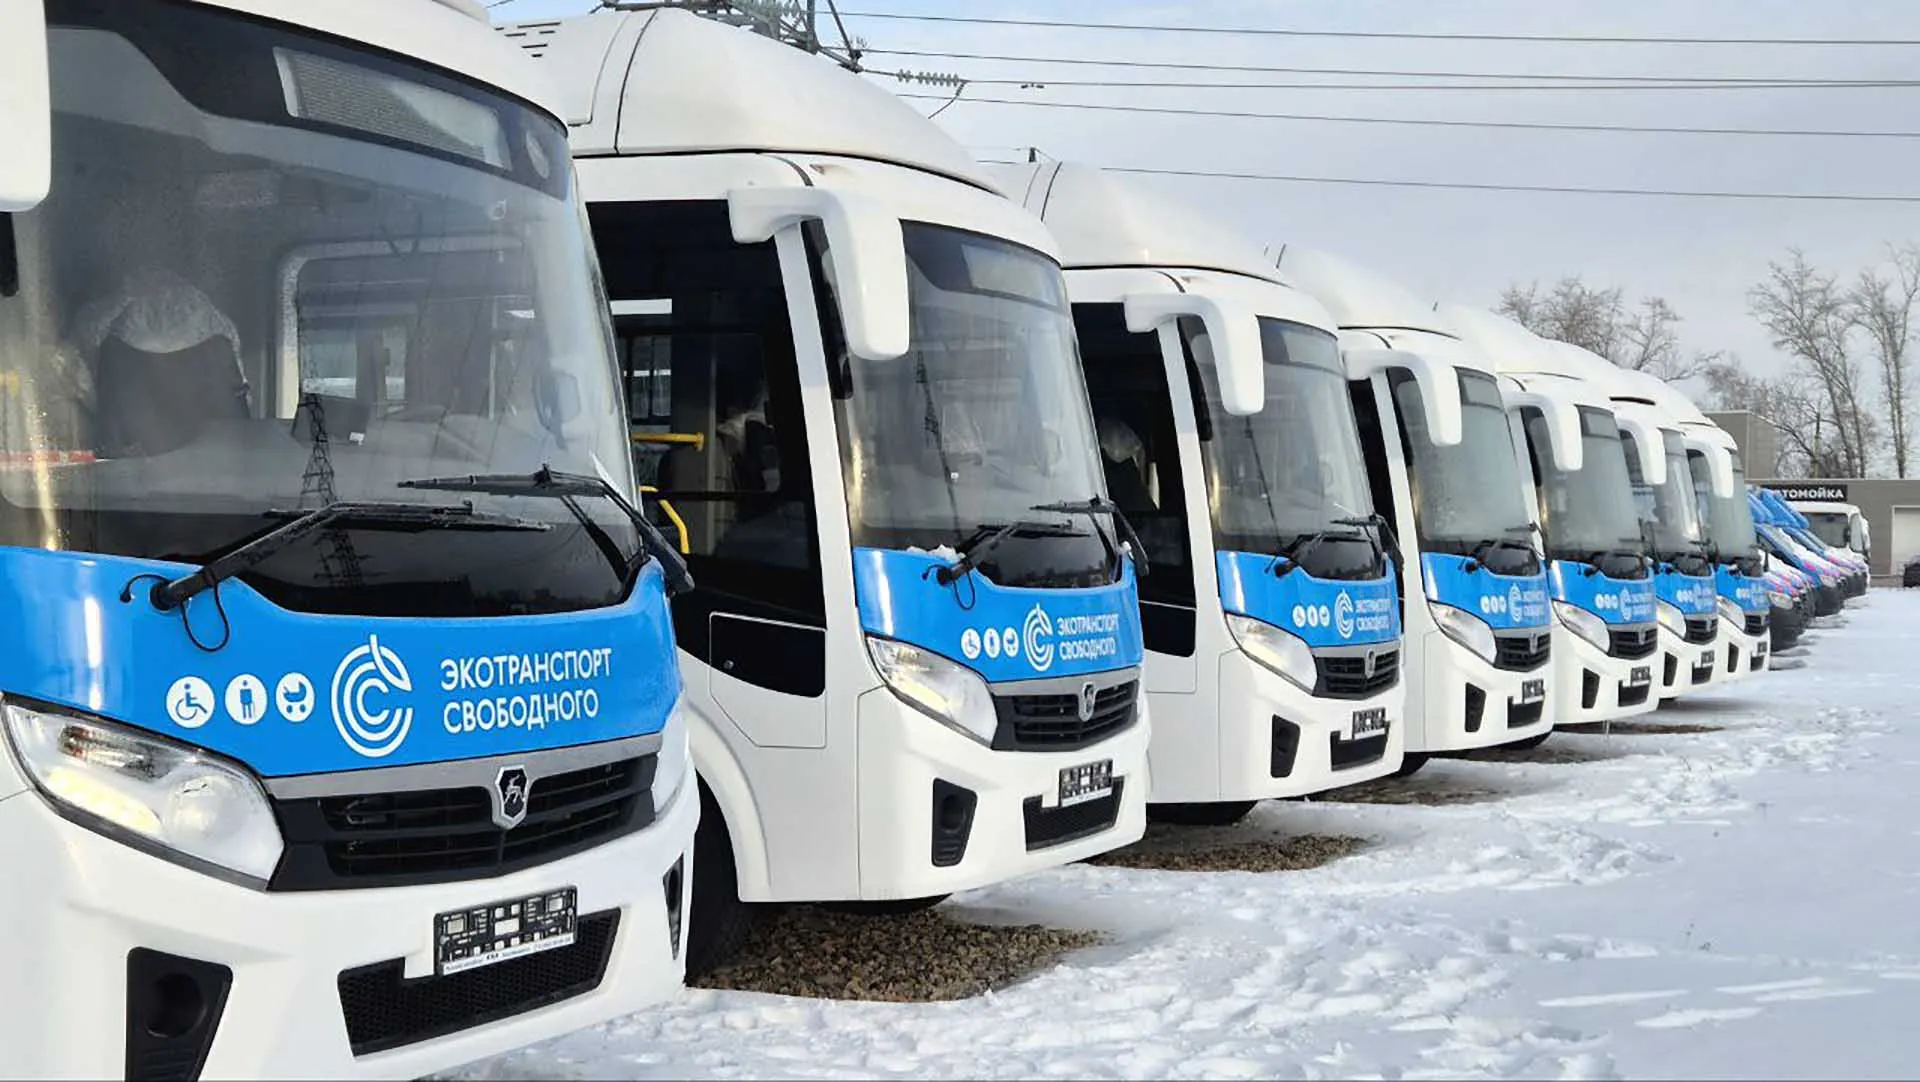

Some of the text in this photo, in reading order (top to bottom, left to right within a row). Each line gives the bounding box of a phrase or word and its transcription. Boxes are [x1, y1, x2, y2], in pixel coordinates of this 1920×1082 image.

[1774, 487, 1844, 499] ТОМОЙКА
[440, 647, 613, 691] ЭКОТРАНСПОРТ
[443, 688, 599, 734] СВОБОДНОГО
